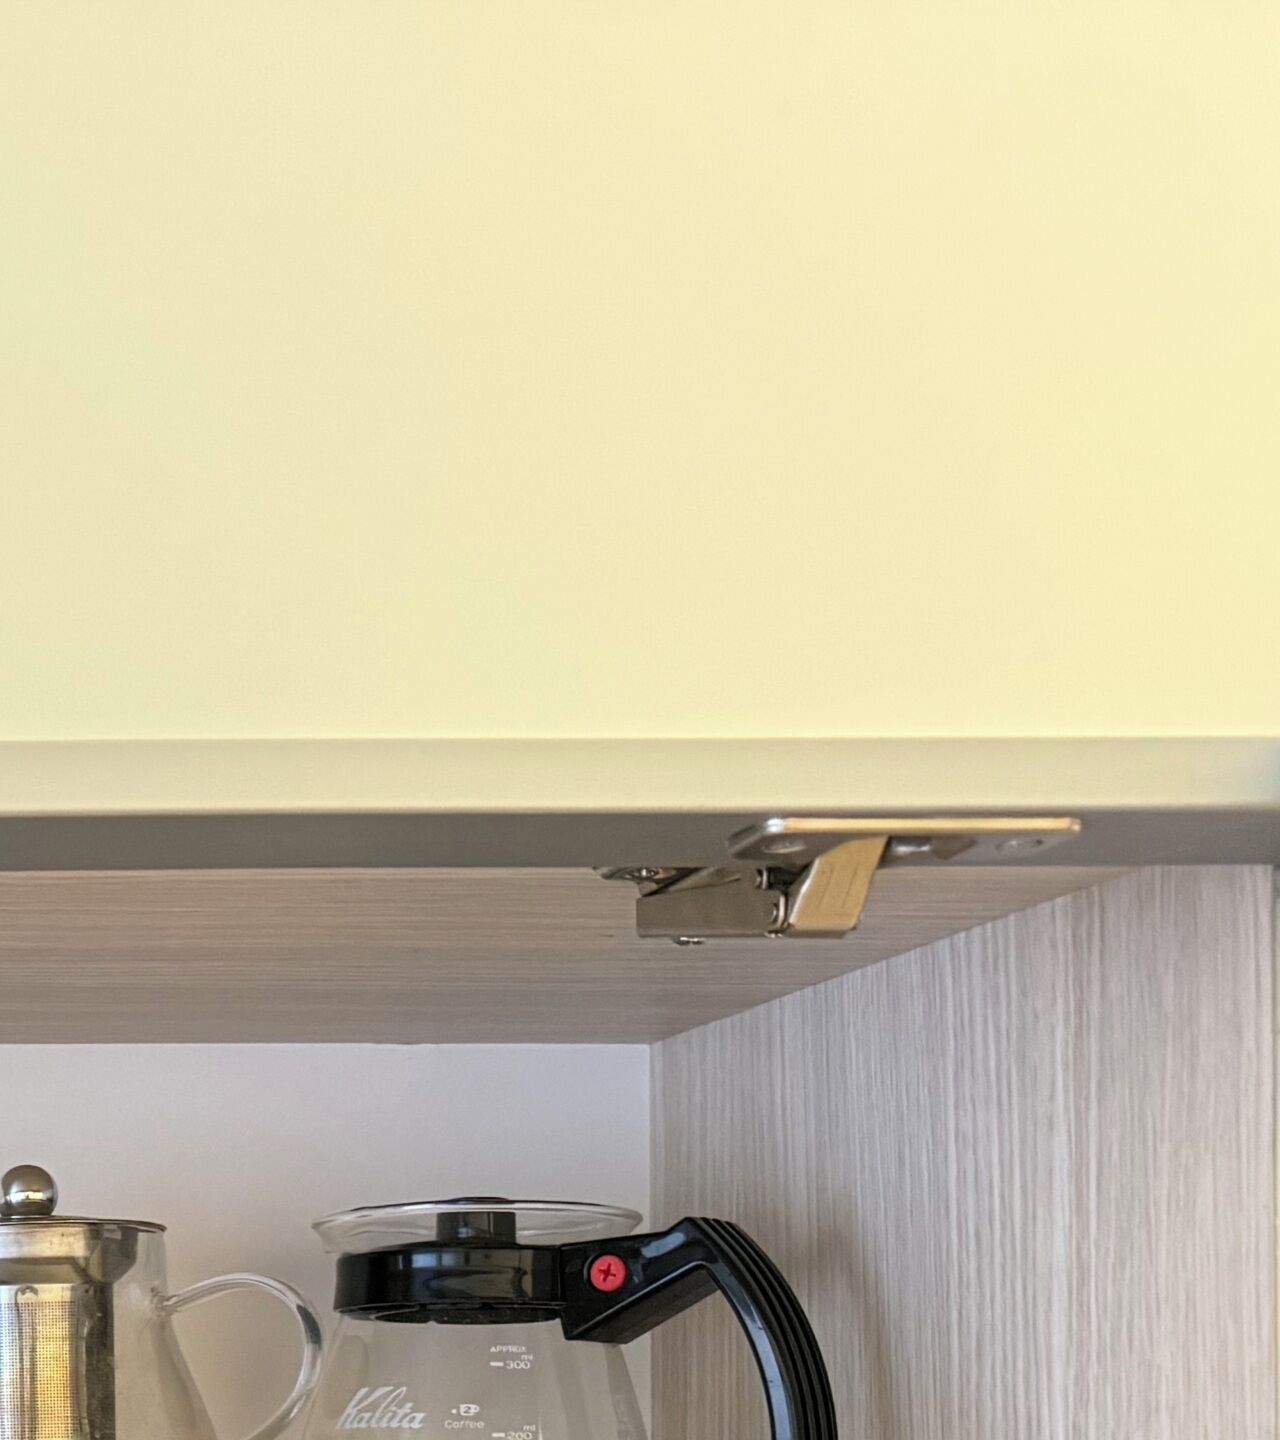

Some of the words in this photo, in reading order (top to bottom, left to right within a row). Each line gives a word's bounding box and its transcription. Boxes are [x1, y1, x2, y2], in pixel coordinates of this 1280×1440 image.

[505, 1360, 531, 1370] 300
[335, 1386, 426, 1430] Kalita
[444, 1419, 485, 1430] Coffee
[506, 1431, 533, 1440] 200
